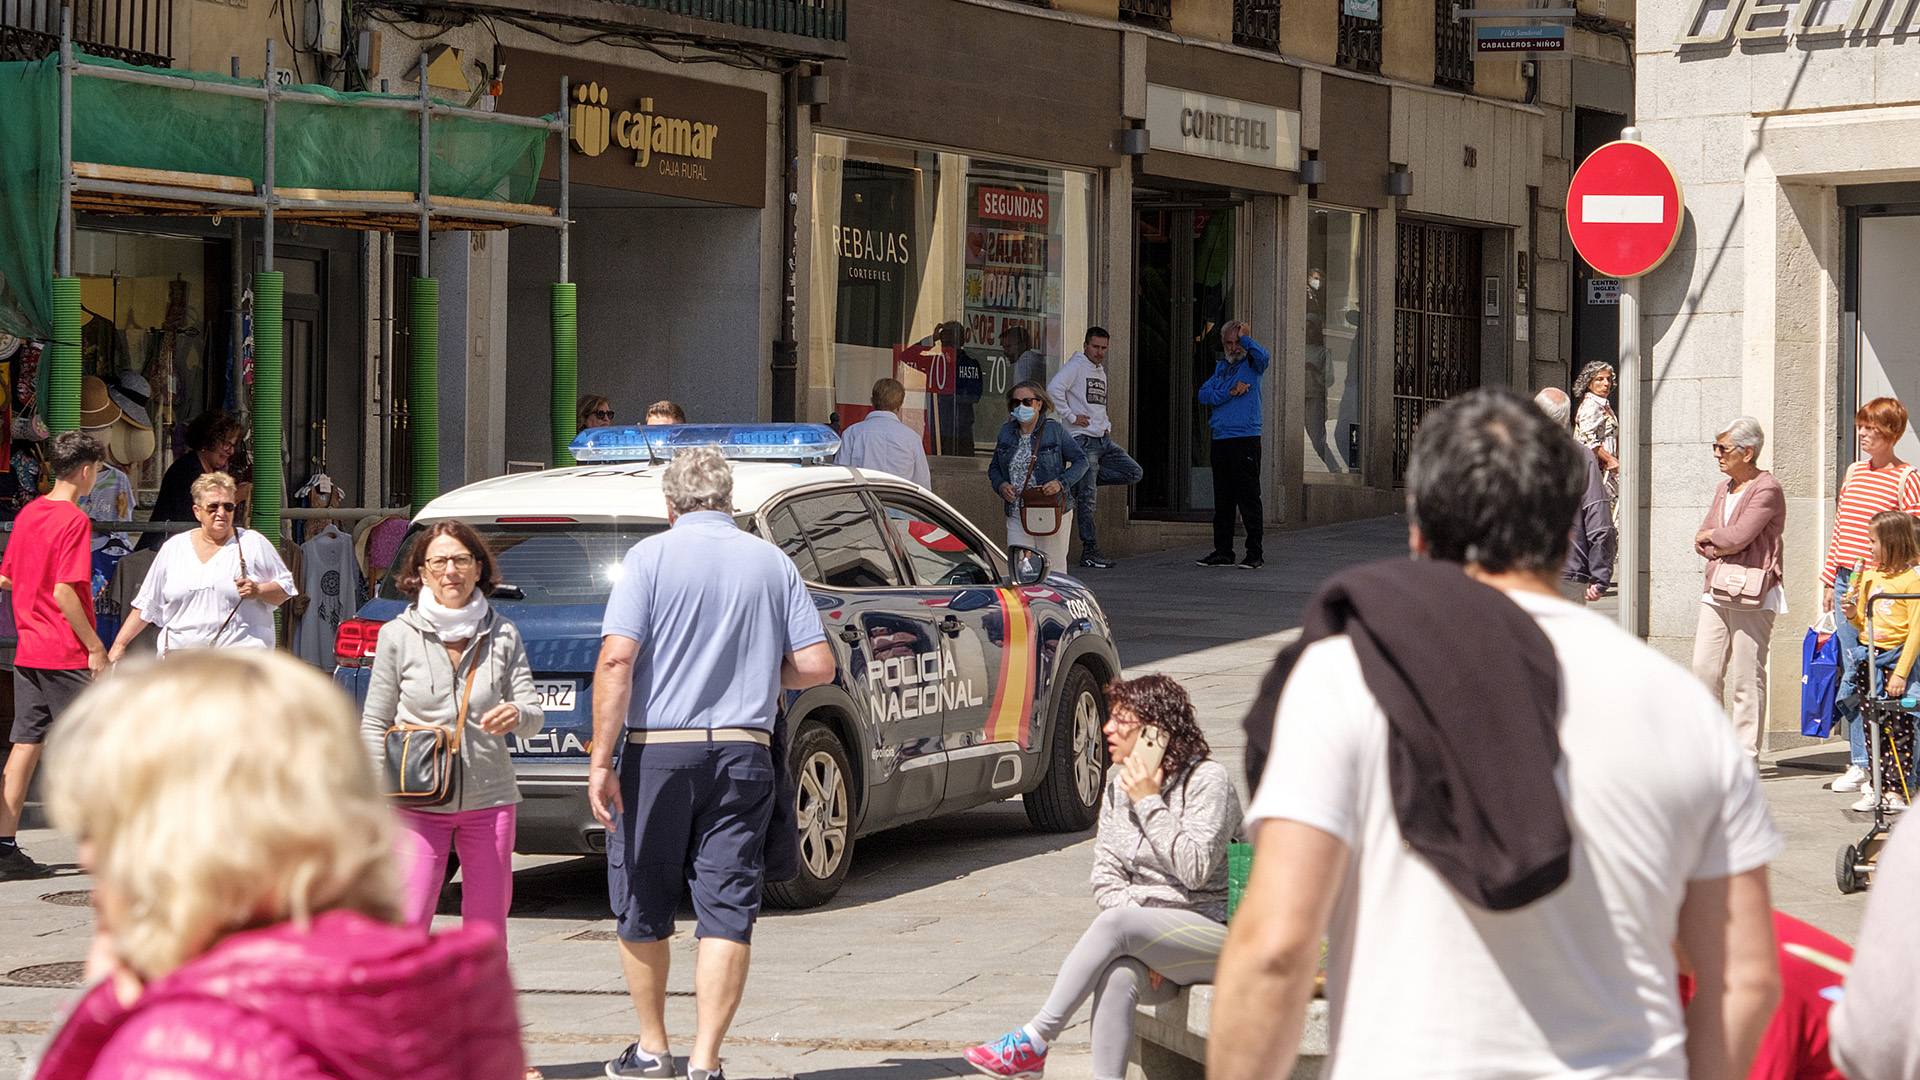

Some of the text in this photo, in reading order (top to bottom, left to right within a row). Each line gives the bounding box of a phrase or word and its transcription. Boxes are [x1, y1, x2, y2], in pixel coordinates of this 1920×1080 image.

[611, 97, 718, 168] cajamar
[1181, 107, 1270, 150] CORTEFIEL
[659, 159, 708, 181] CAJA RURAL
[985, 192, 1044, 219] SEGUNDAS
[832, 224, 909, 264] REBAJAS
[848, 267, 892, 282] CORTEFIEL
[959, 366, 979, 380] HASTA
[871, 679, 983, 724] NACIONAL
